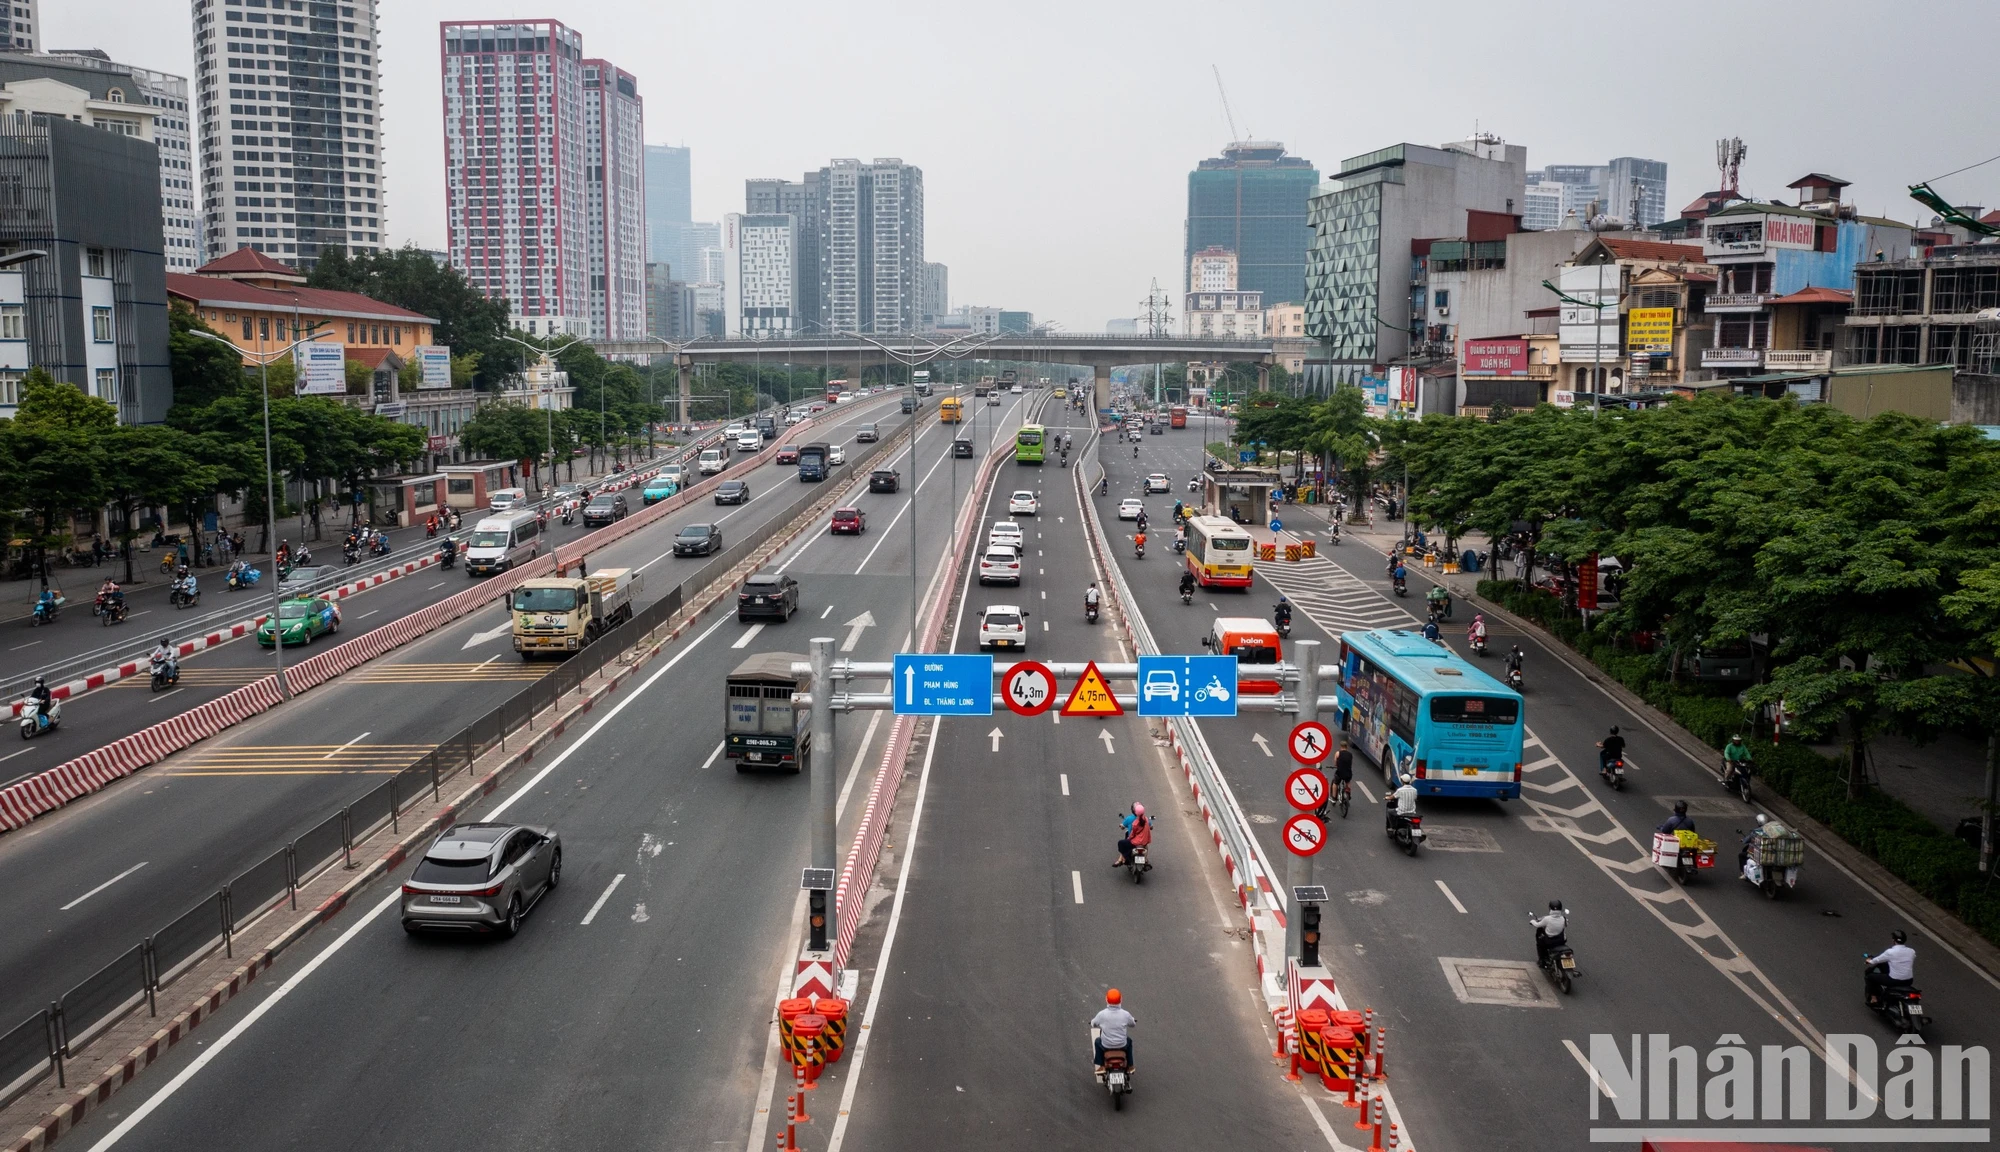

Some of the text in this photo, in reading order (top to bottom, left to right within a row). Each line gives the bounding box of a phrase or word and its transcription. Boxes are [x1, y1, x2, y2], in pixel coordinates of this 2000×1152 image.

[1789, 218, 1814, 245] NGHỈ
[1487, 344, 1496, 355] CÁO
[1506, 344, 1521, 356] THUẬT
[544, 615, 561, 625] Sky
[924, 663, 944, 672] ĐƯỜNG
[924, 680, 959, 690] PHẠM HÙNG
[1013, 677, 1044, 700] 4,3m
[924, 696, 974, 706] ĐL. THĂNG LONG
[1078, 690, 1107, 703] 4,75m
